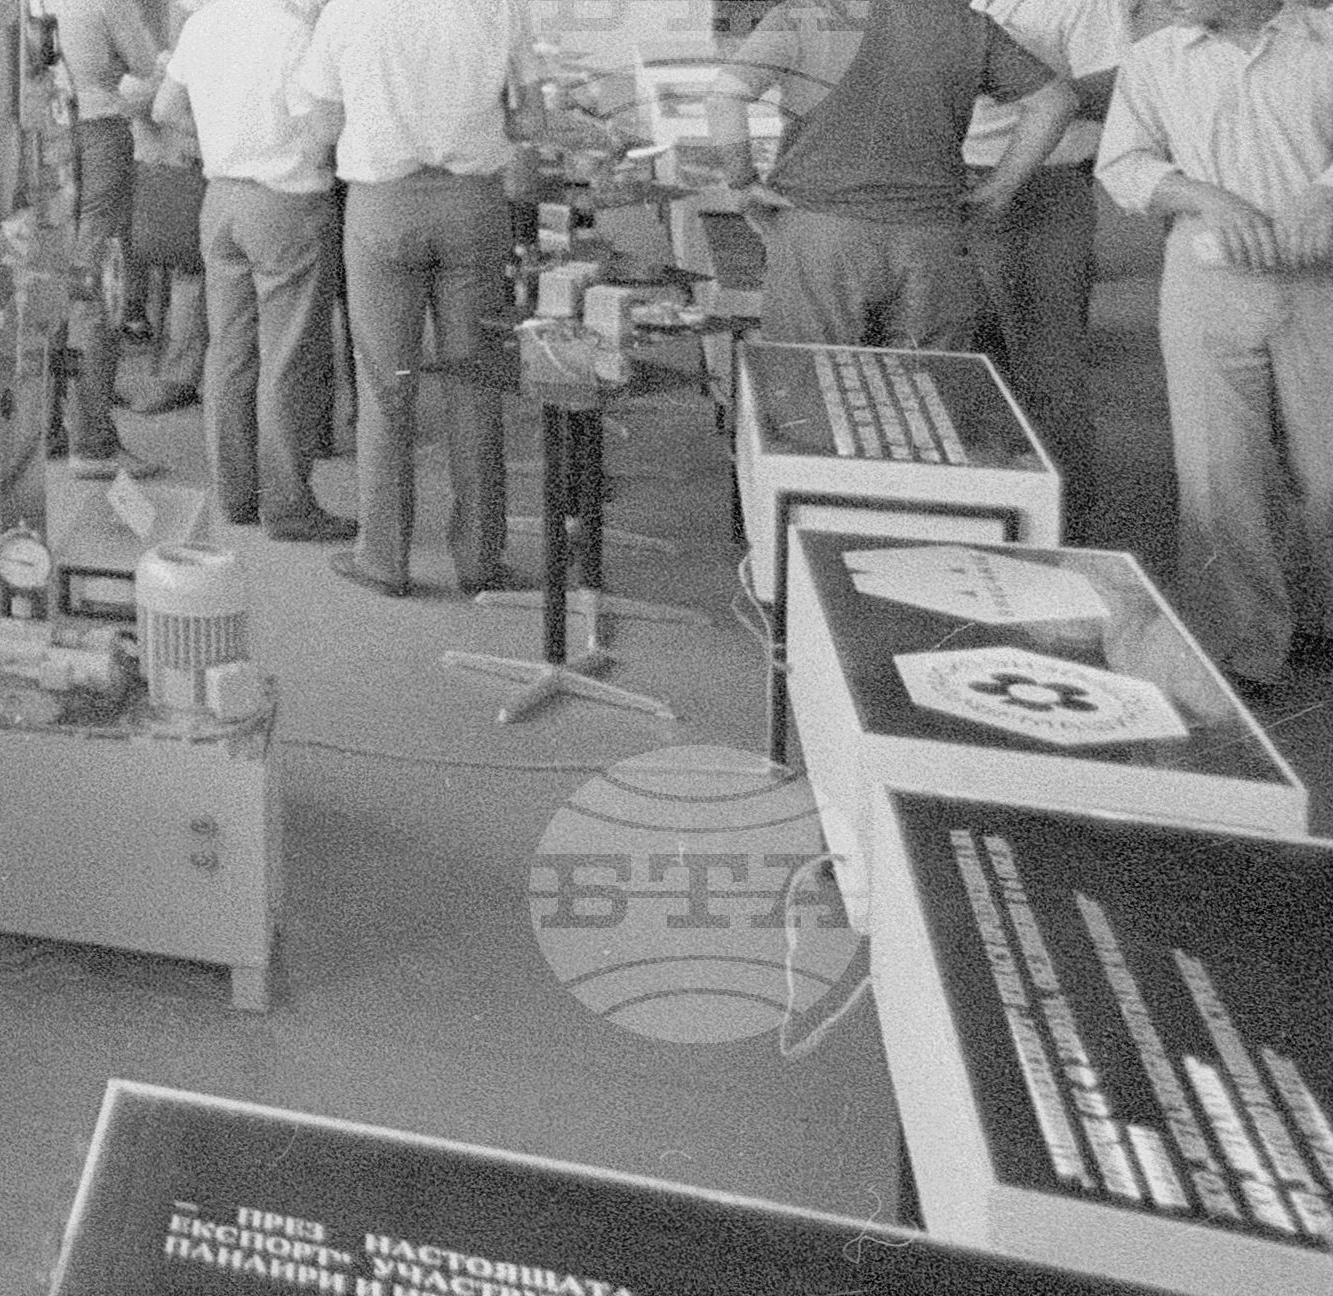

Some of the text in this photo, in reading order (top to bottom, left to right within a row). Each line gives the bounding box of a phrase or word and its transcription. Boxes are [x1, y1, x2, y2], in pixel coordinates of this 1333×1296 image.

[239, 1206, 325, 1241] ПРЕЗ
[166, 1235, 345, 1293] ПАНАИРИ
[374, 1257, 537, 1296] УЧАСТ
